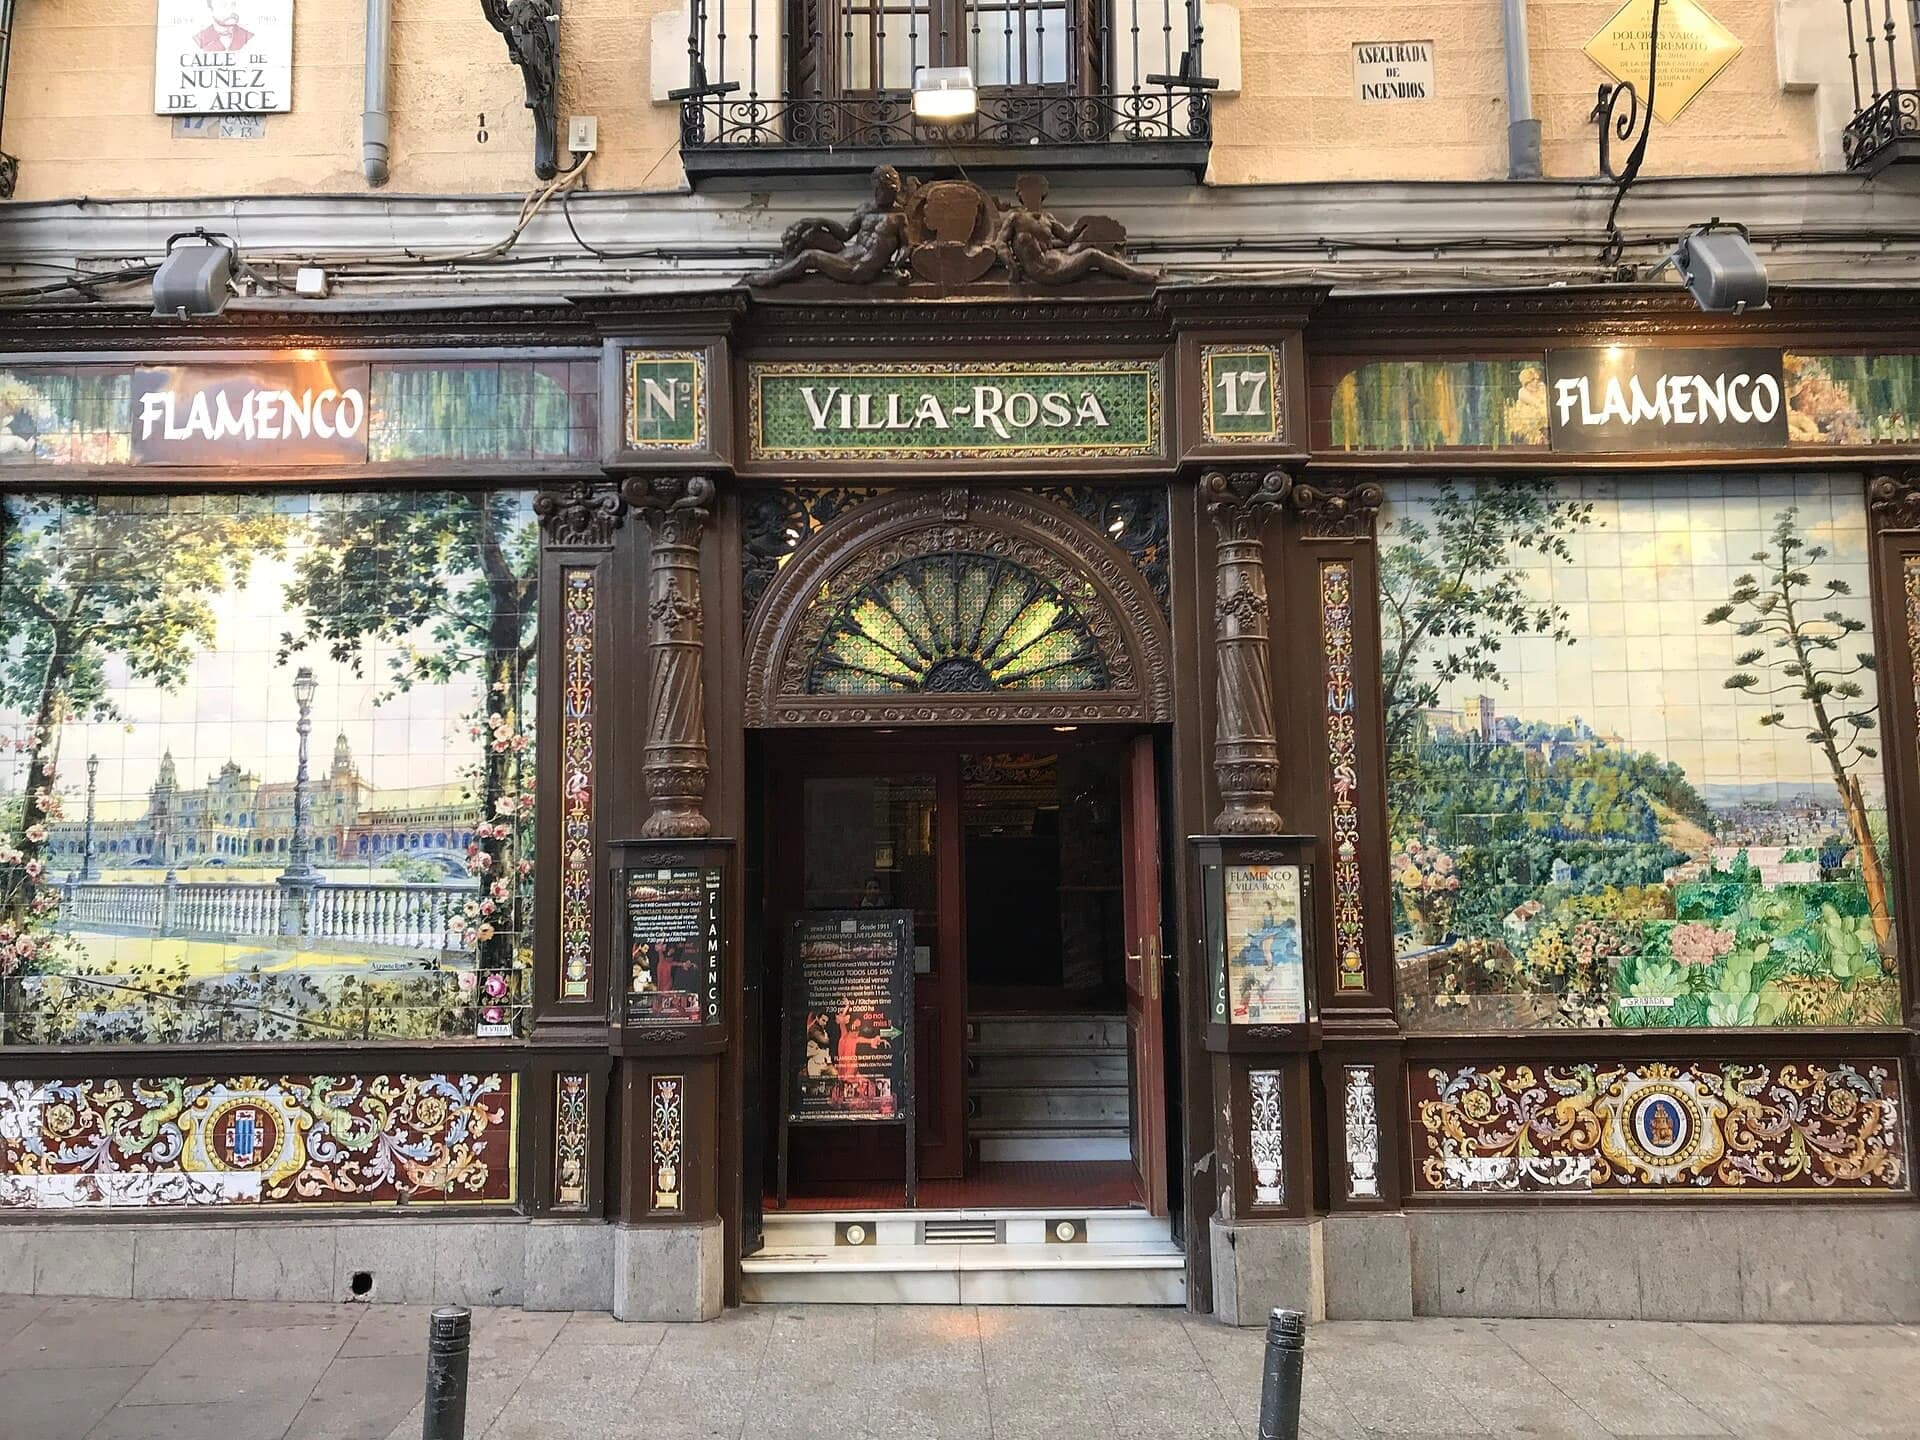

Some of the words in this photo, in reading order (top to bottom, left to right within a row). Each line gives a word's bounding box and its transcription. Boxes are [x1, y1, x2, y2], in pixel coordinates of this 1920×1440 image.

[1613, 31, 1666, 40] DOLORS
[180, 53, 236, 67] CALLE
[249, 54, 268, 64] DE
[1357, 45, 1428, 64] ASEGURADA
[180, 67, 265, 89] NUÑEZ
[1386, 67, 1400, 78] DE
[1362, 82, 1426, 100] INCENDIOS
[168, 94, 198, 109] DE
[209, 91, 279, 111] ARCE
[224, 115, 260, 126] CASA
[240, 126, 253, 137] 13
[1216, 371, 1267, 416] 17
[1554, 372, 1780, 428] FLAMENCO
[139, 388, 364, 441] FLAMENCO
[1230, 871, 1292, 882] FLAMENCO
[1262, 882, 1286, 890] ROSA
